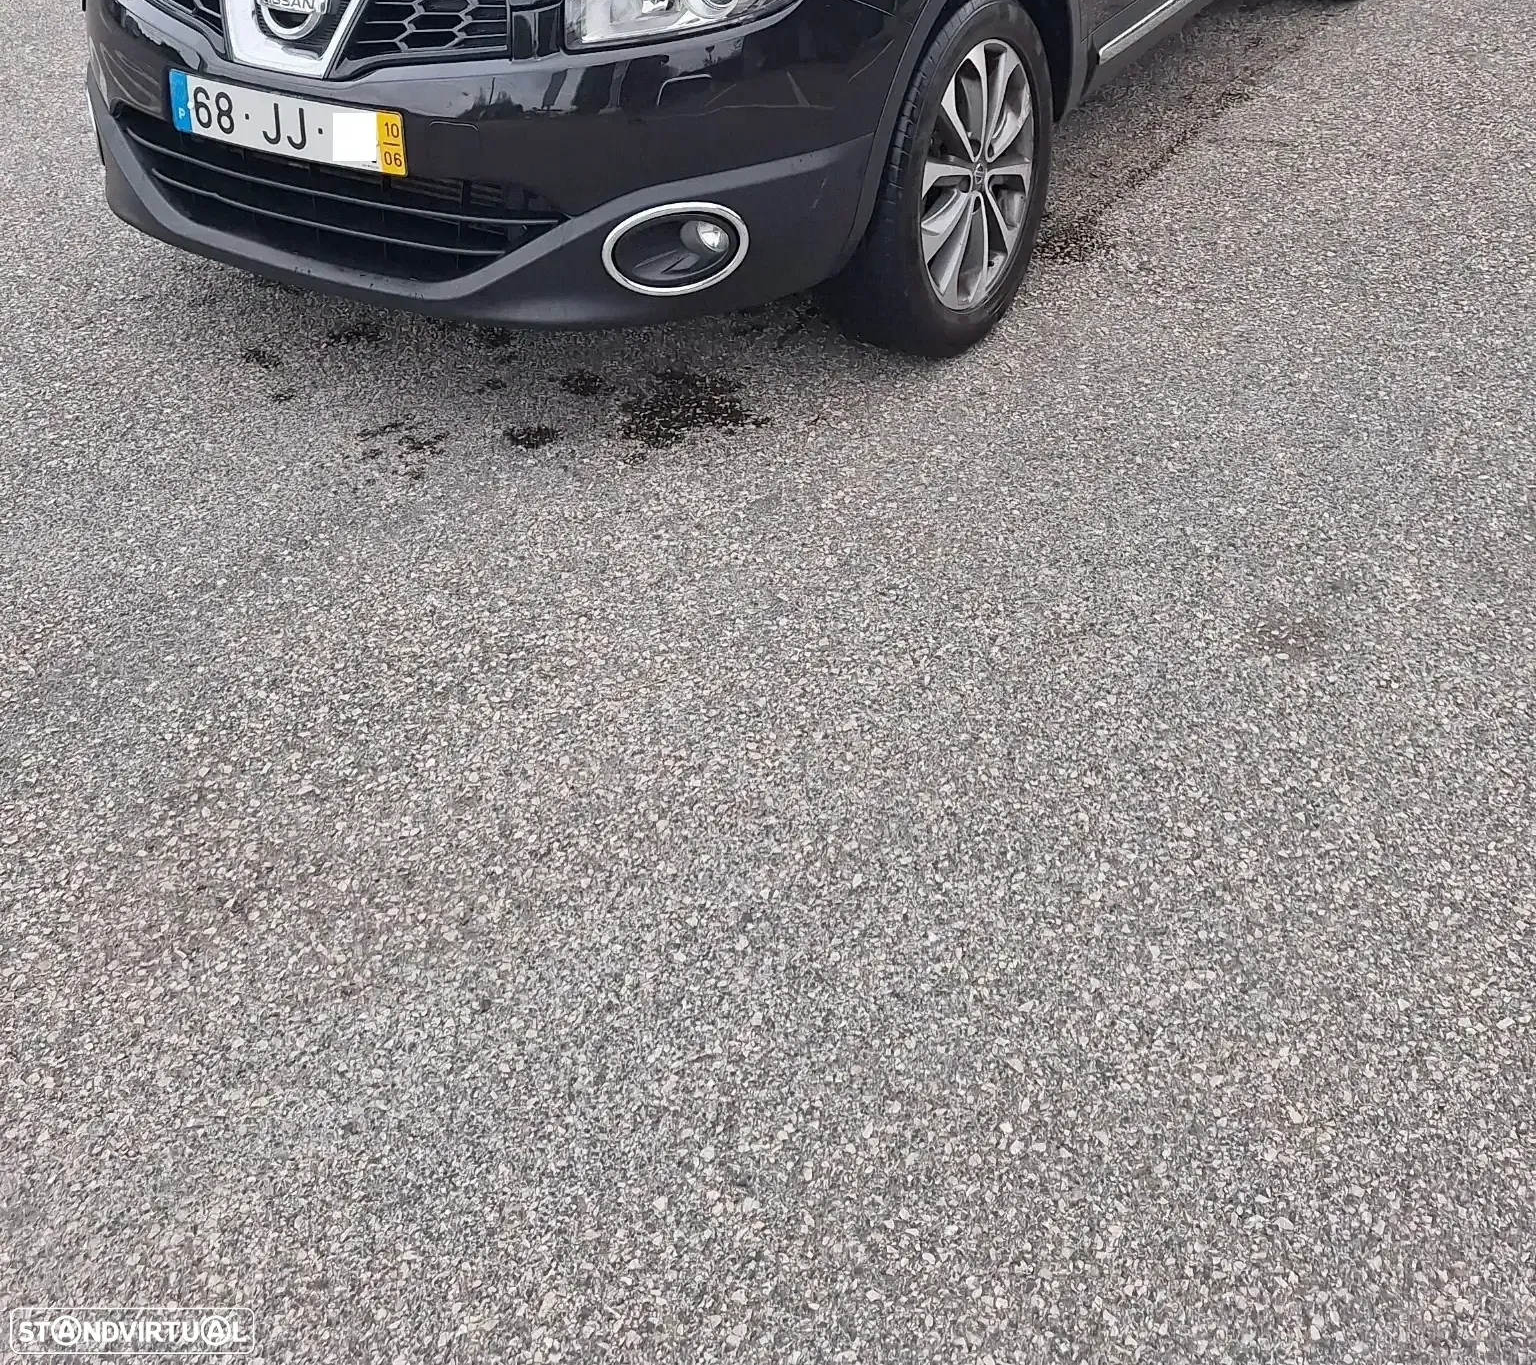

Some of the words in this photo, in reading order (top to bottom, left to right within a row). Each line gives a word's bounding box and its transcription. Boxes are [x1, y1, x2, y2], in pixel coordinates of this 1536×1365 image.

[178, 106, 186, 120] P
[193, 86, 235, 135] 68
[262, 102, 307, 151] JJ
[384, 121, 400, 138] 10
[383, 151, 403, 168] 06
